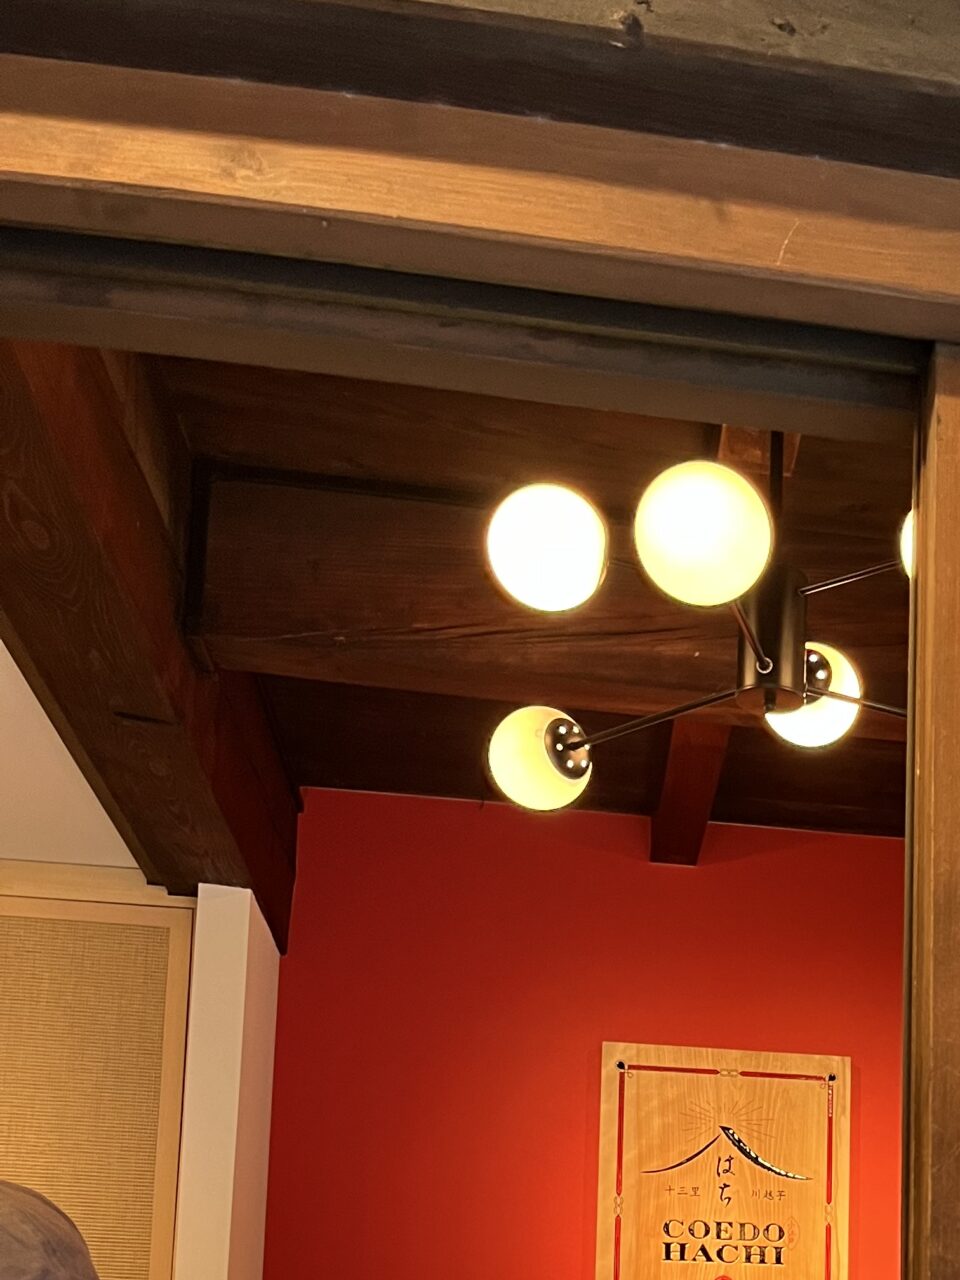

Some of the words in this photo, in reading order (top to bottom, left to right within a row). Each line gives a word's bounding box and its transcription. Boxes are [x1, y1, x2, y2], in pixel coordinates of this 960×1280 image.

[664, 1185, 702, 1198] 十三里
[716, 1155, 736, 1208] はち
[751, 1189, 787, 1202] 川越芋
[663, 1219, 786, 1243] COEDO
[662, 1241, 785, 1265] HACHI
